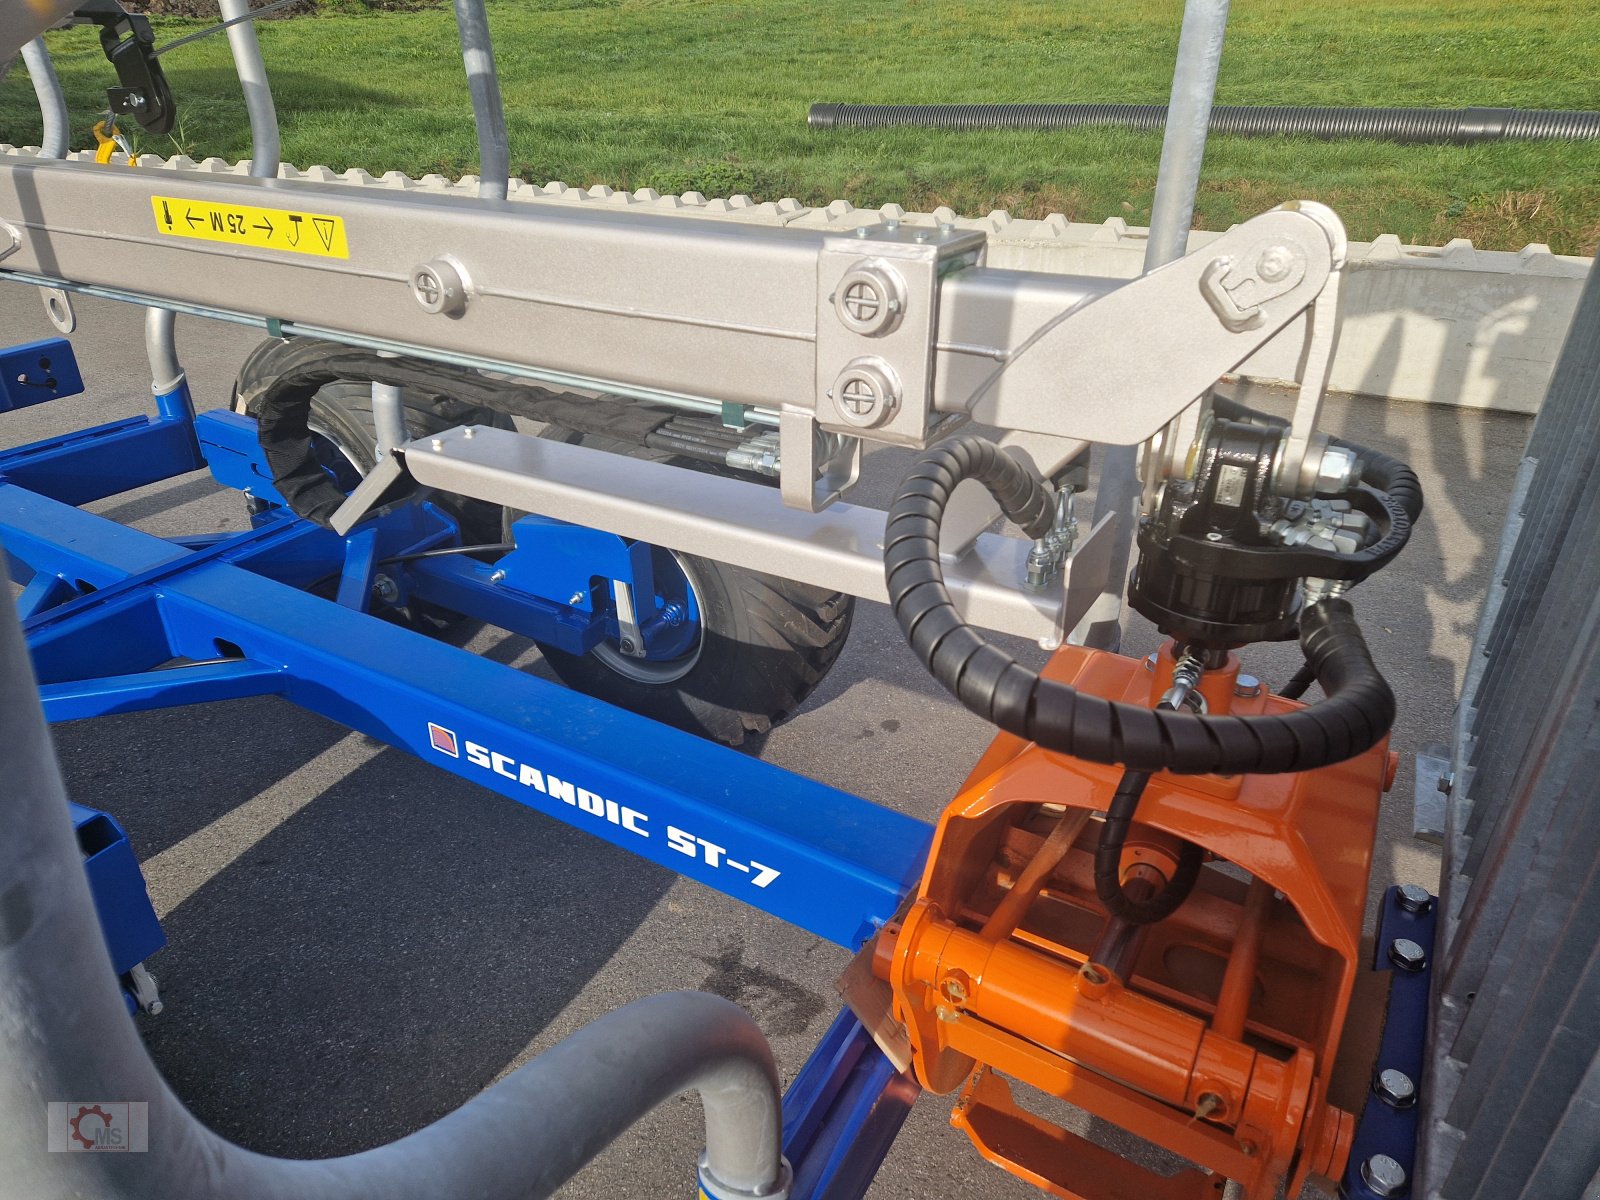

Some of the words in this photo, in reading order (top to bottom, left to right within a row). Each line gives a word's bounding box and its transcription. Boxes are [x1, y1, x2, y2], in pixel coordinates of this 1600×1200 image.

[209, 211, 224, 232] M
[228, 214, 246, 235] 25
[465, 740, 649, 838] SCANDIC
[667, 825, 782, 889] ST-7
